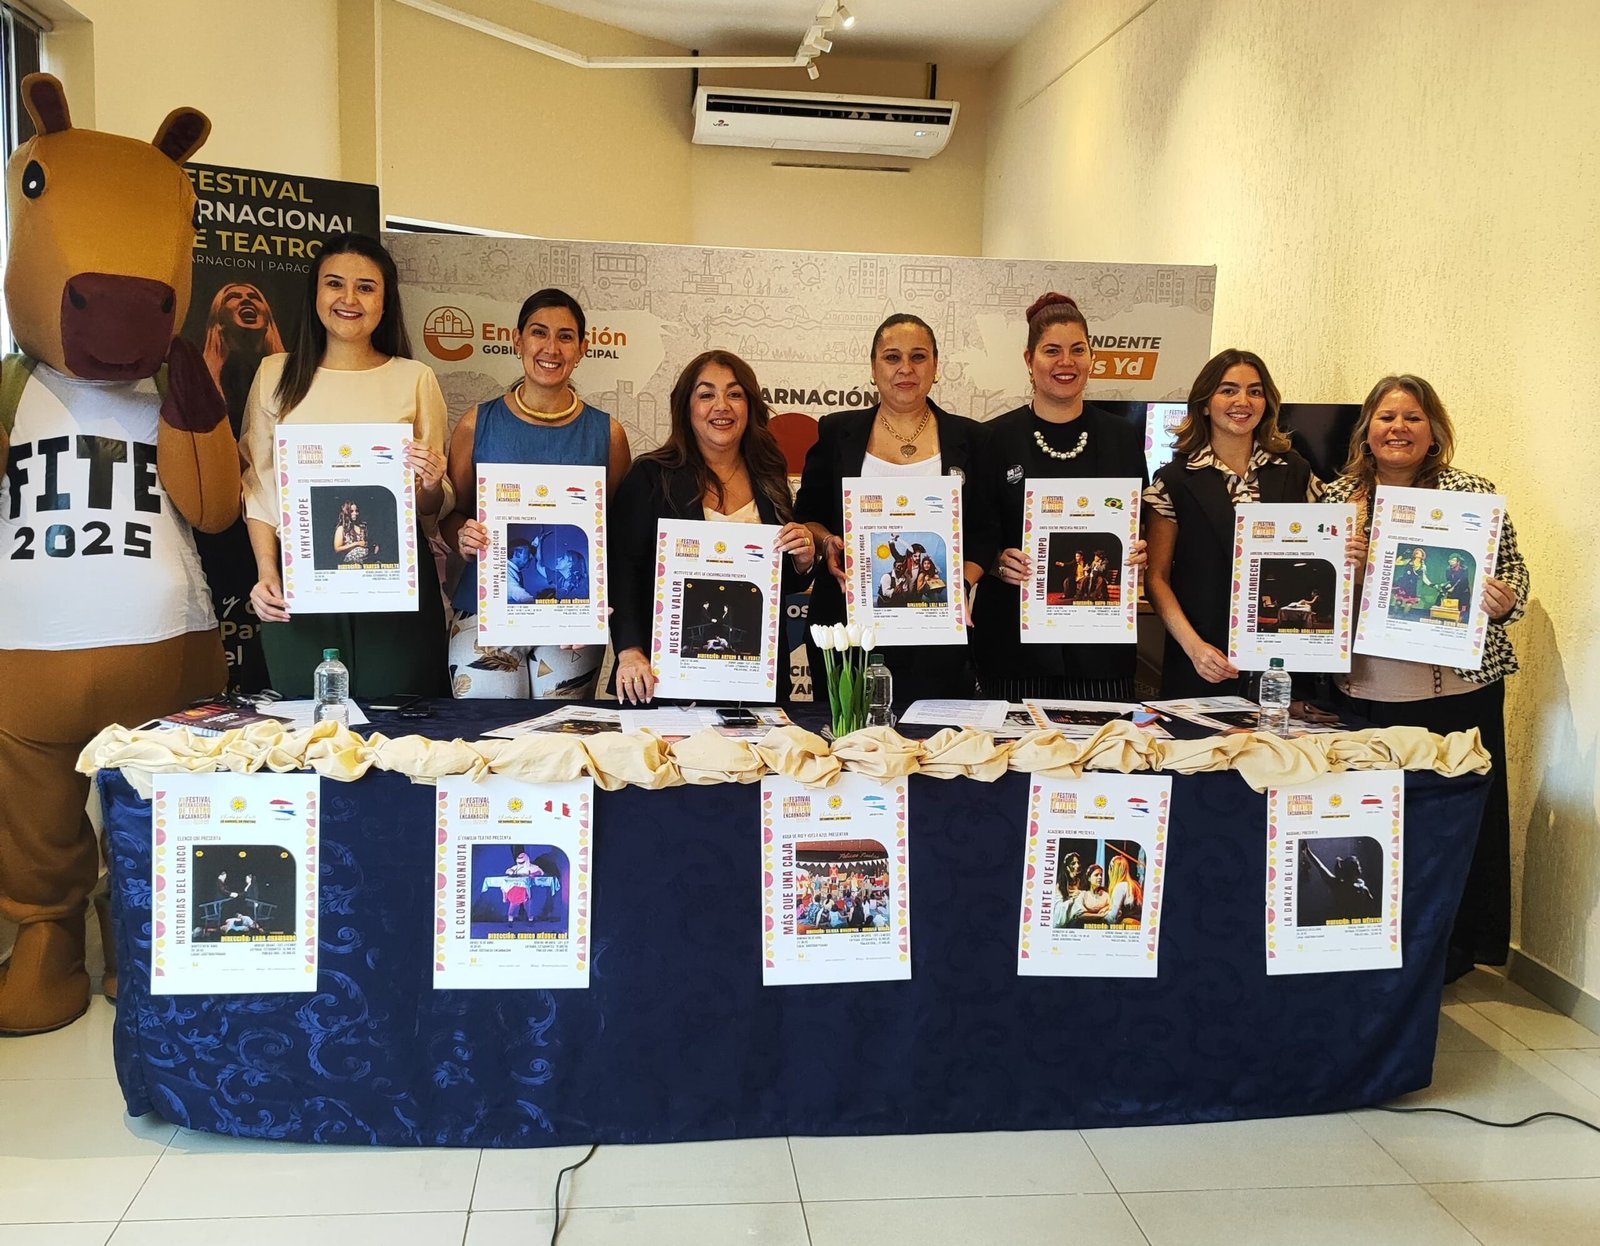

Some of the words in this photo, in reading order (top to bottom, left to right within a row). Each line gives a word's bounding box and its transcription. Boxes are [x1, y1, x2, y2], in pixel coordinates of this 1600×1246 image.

[192, 256, 256, 270] RNACION
[268, 261, 310, 274] PARAG
[1114, 357, 1144, 376] Yd
[761, 386, 880, 408] ARNACIÓN
[6, 435, 161, 519] FITE
[10, 521, 152, 559] 2025
[298, 497, 312, 559] KYHYJEPÓPE
[1038, 537, 1047, 563] TEMPO
[1037, 564, 1046, 575] DO
[1248, 558, 1259, 600] ATARDECER
[1377, 550, 1395, 609] CIRCONSCIENTE
[672, 580, 682, 609] VALOR
[1036, 577, 1045, 600] LIAME
[1247, 602, 1257, 633] BLANCO
[670, 613, 681, 654] NUESTRO
[782, 842, 793, 867] CAJA
[1285, 839, 1294, 854] IRA
[176, 845, 186, 874] CHACO
[1043, 838, 1057, 885] OVEJUNA
[1285, 858, 1294, 868] LA
[176, 878, 187, 894] DEL
[456, 844, 467, 925] CLOWNSMONAUTA
[782, 870, 793, 889] UNA
[1285, 870, 1294, 882] DE
[783, 893, 794, 912] QUE
[1040, 889, 1052, 928] FUENTE
[1284, 884, 1293, 913] DANZA
[176, 898, 187, 945] HISTORIAS
[456, 929, 465, 939] EL
[782, 914, 794, 935] MÁS
[1284, 918, 1293, 927] LA
